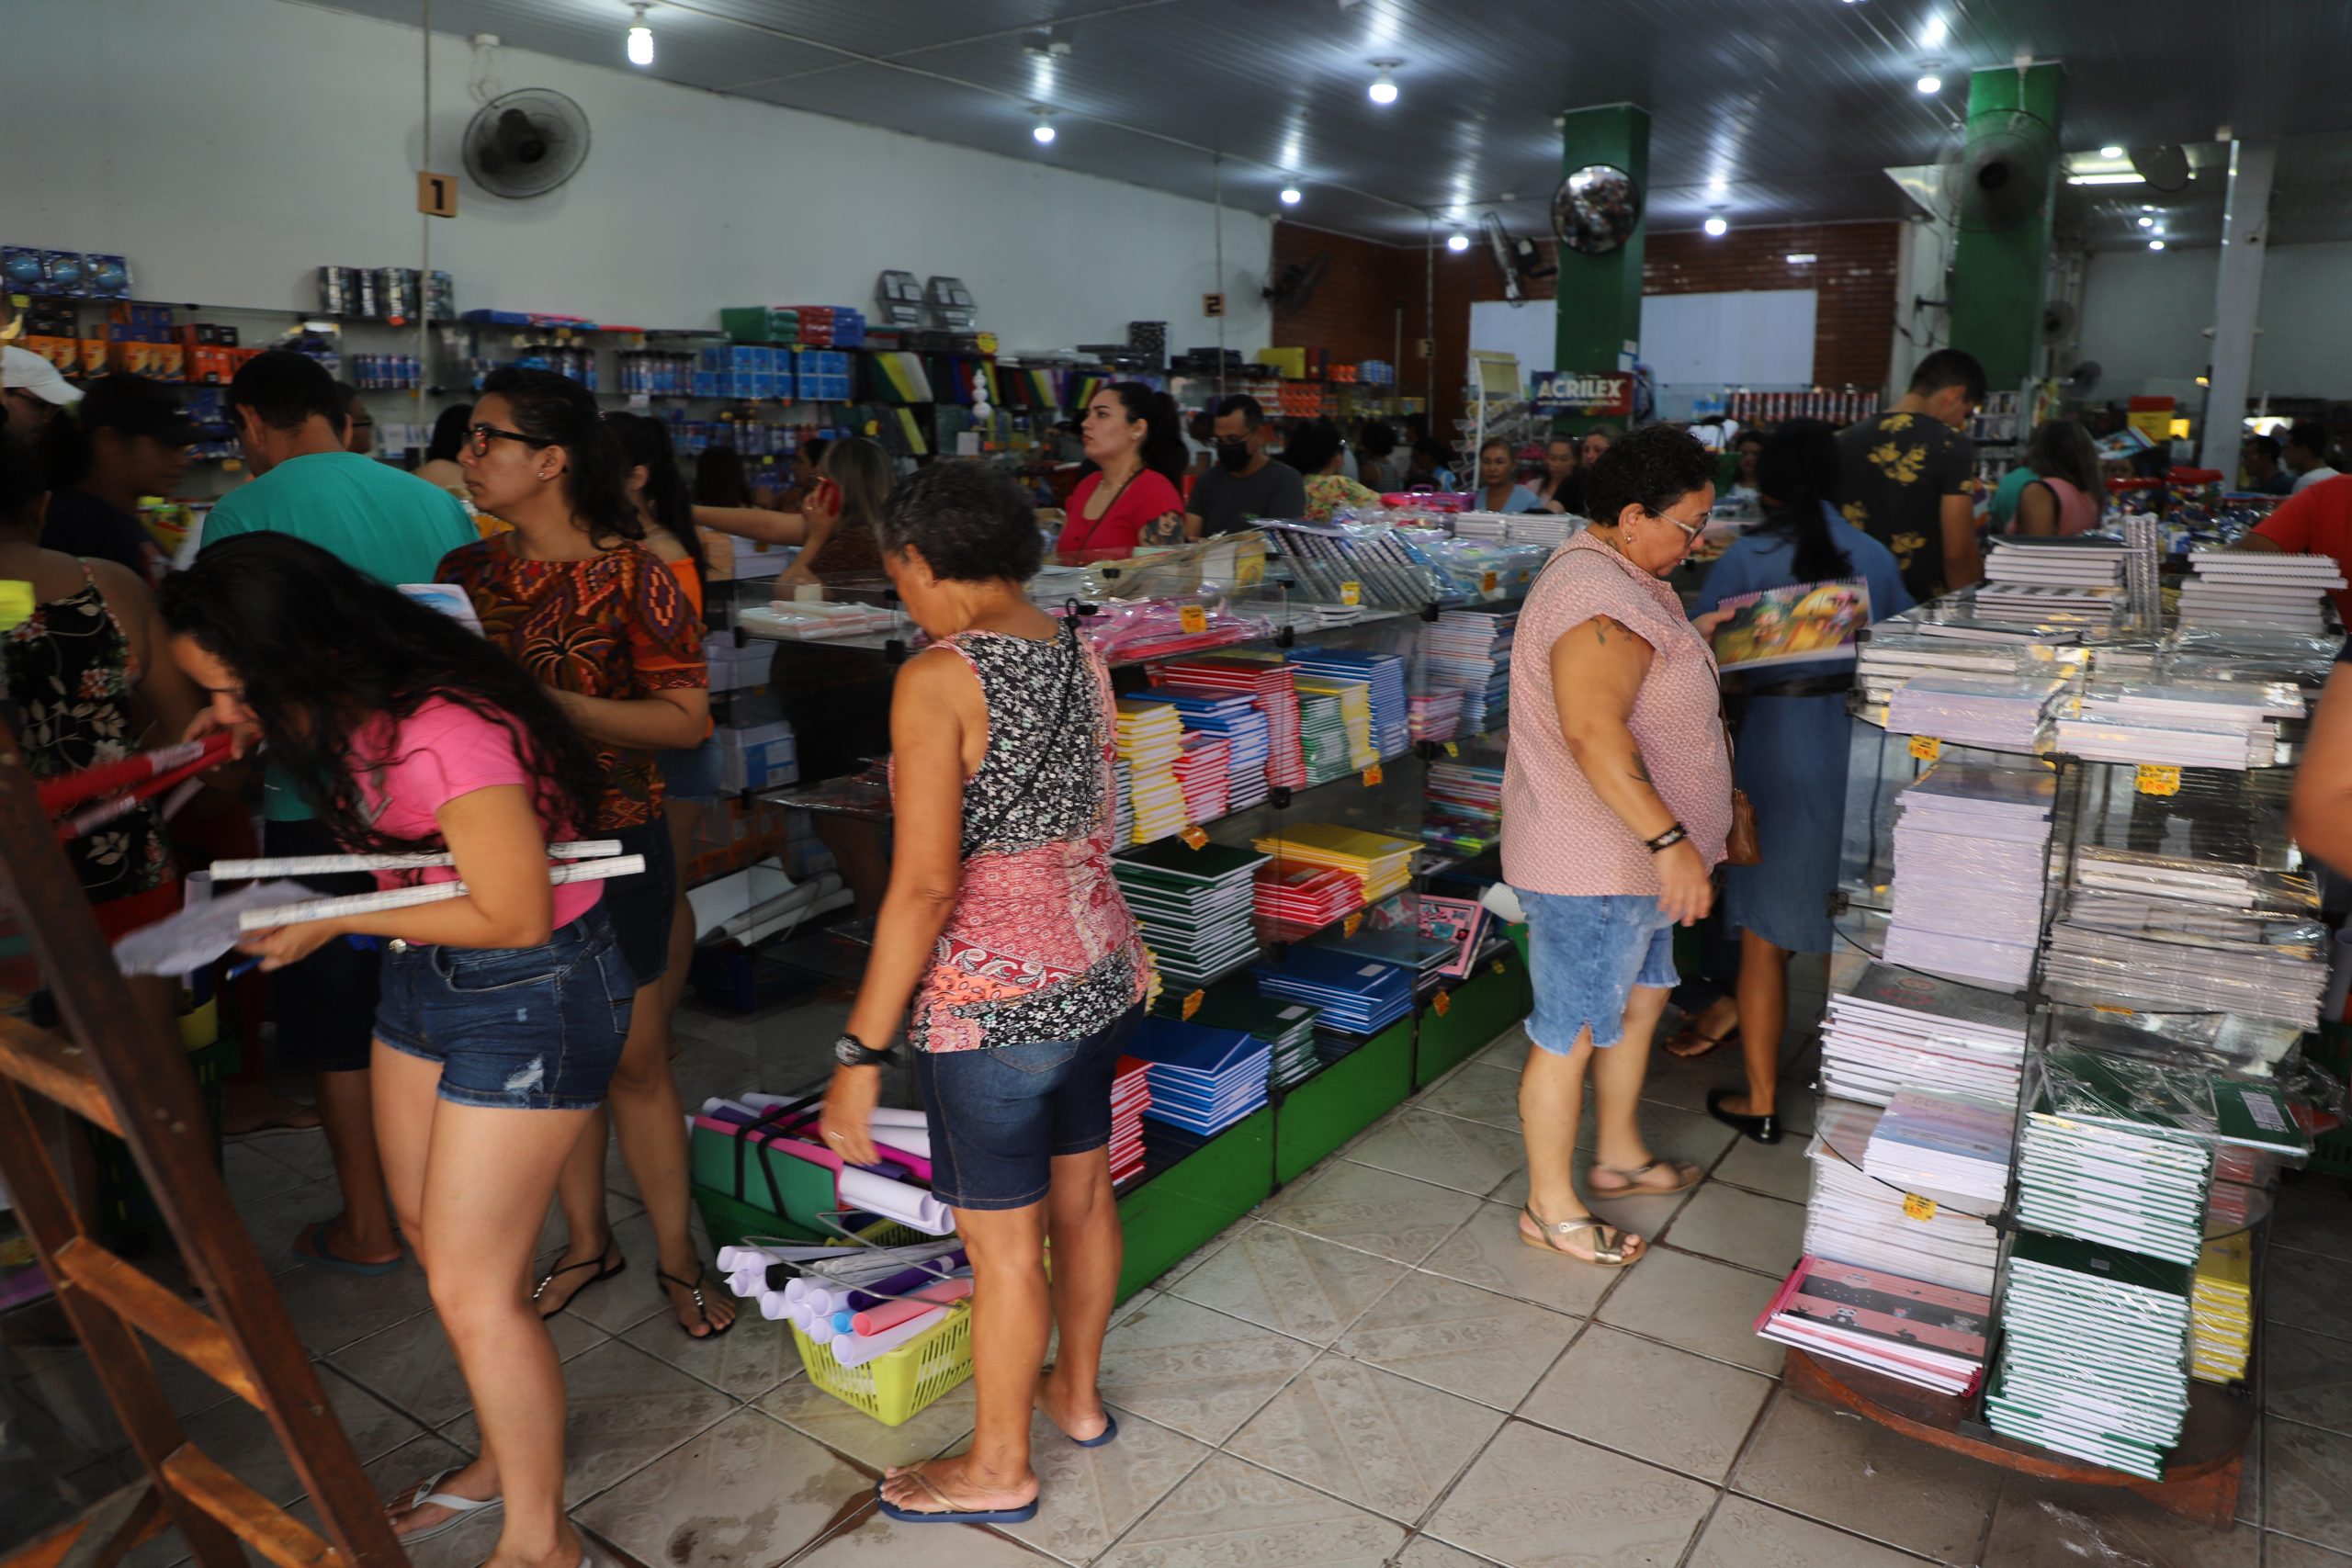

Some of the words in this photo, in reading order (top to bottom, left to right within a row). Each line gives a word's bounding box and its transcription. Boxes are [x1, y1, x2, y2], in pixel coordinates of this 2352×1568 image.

[430, 179, 445, 209] 1
[1206, 296, 1220, 313] 2
[1538, 379, 1623, 398] ACRILEX
